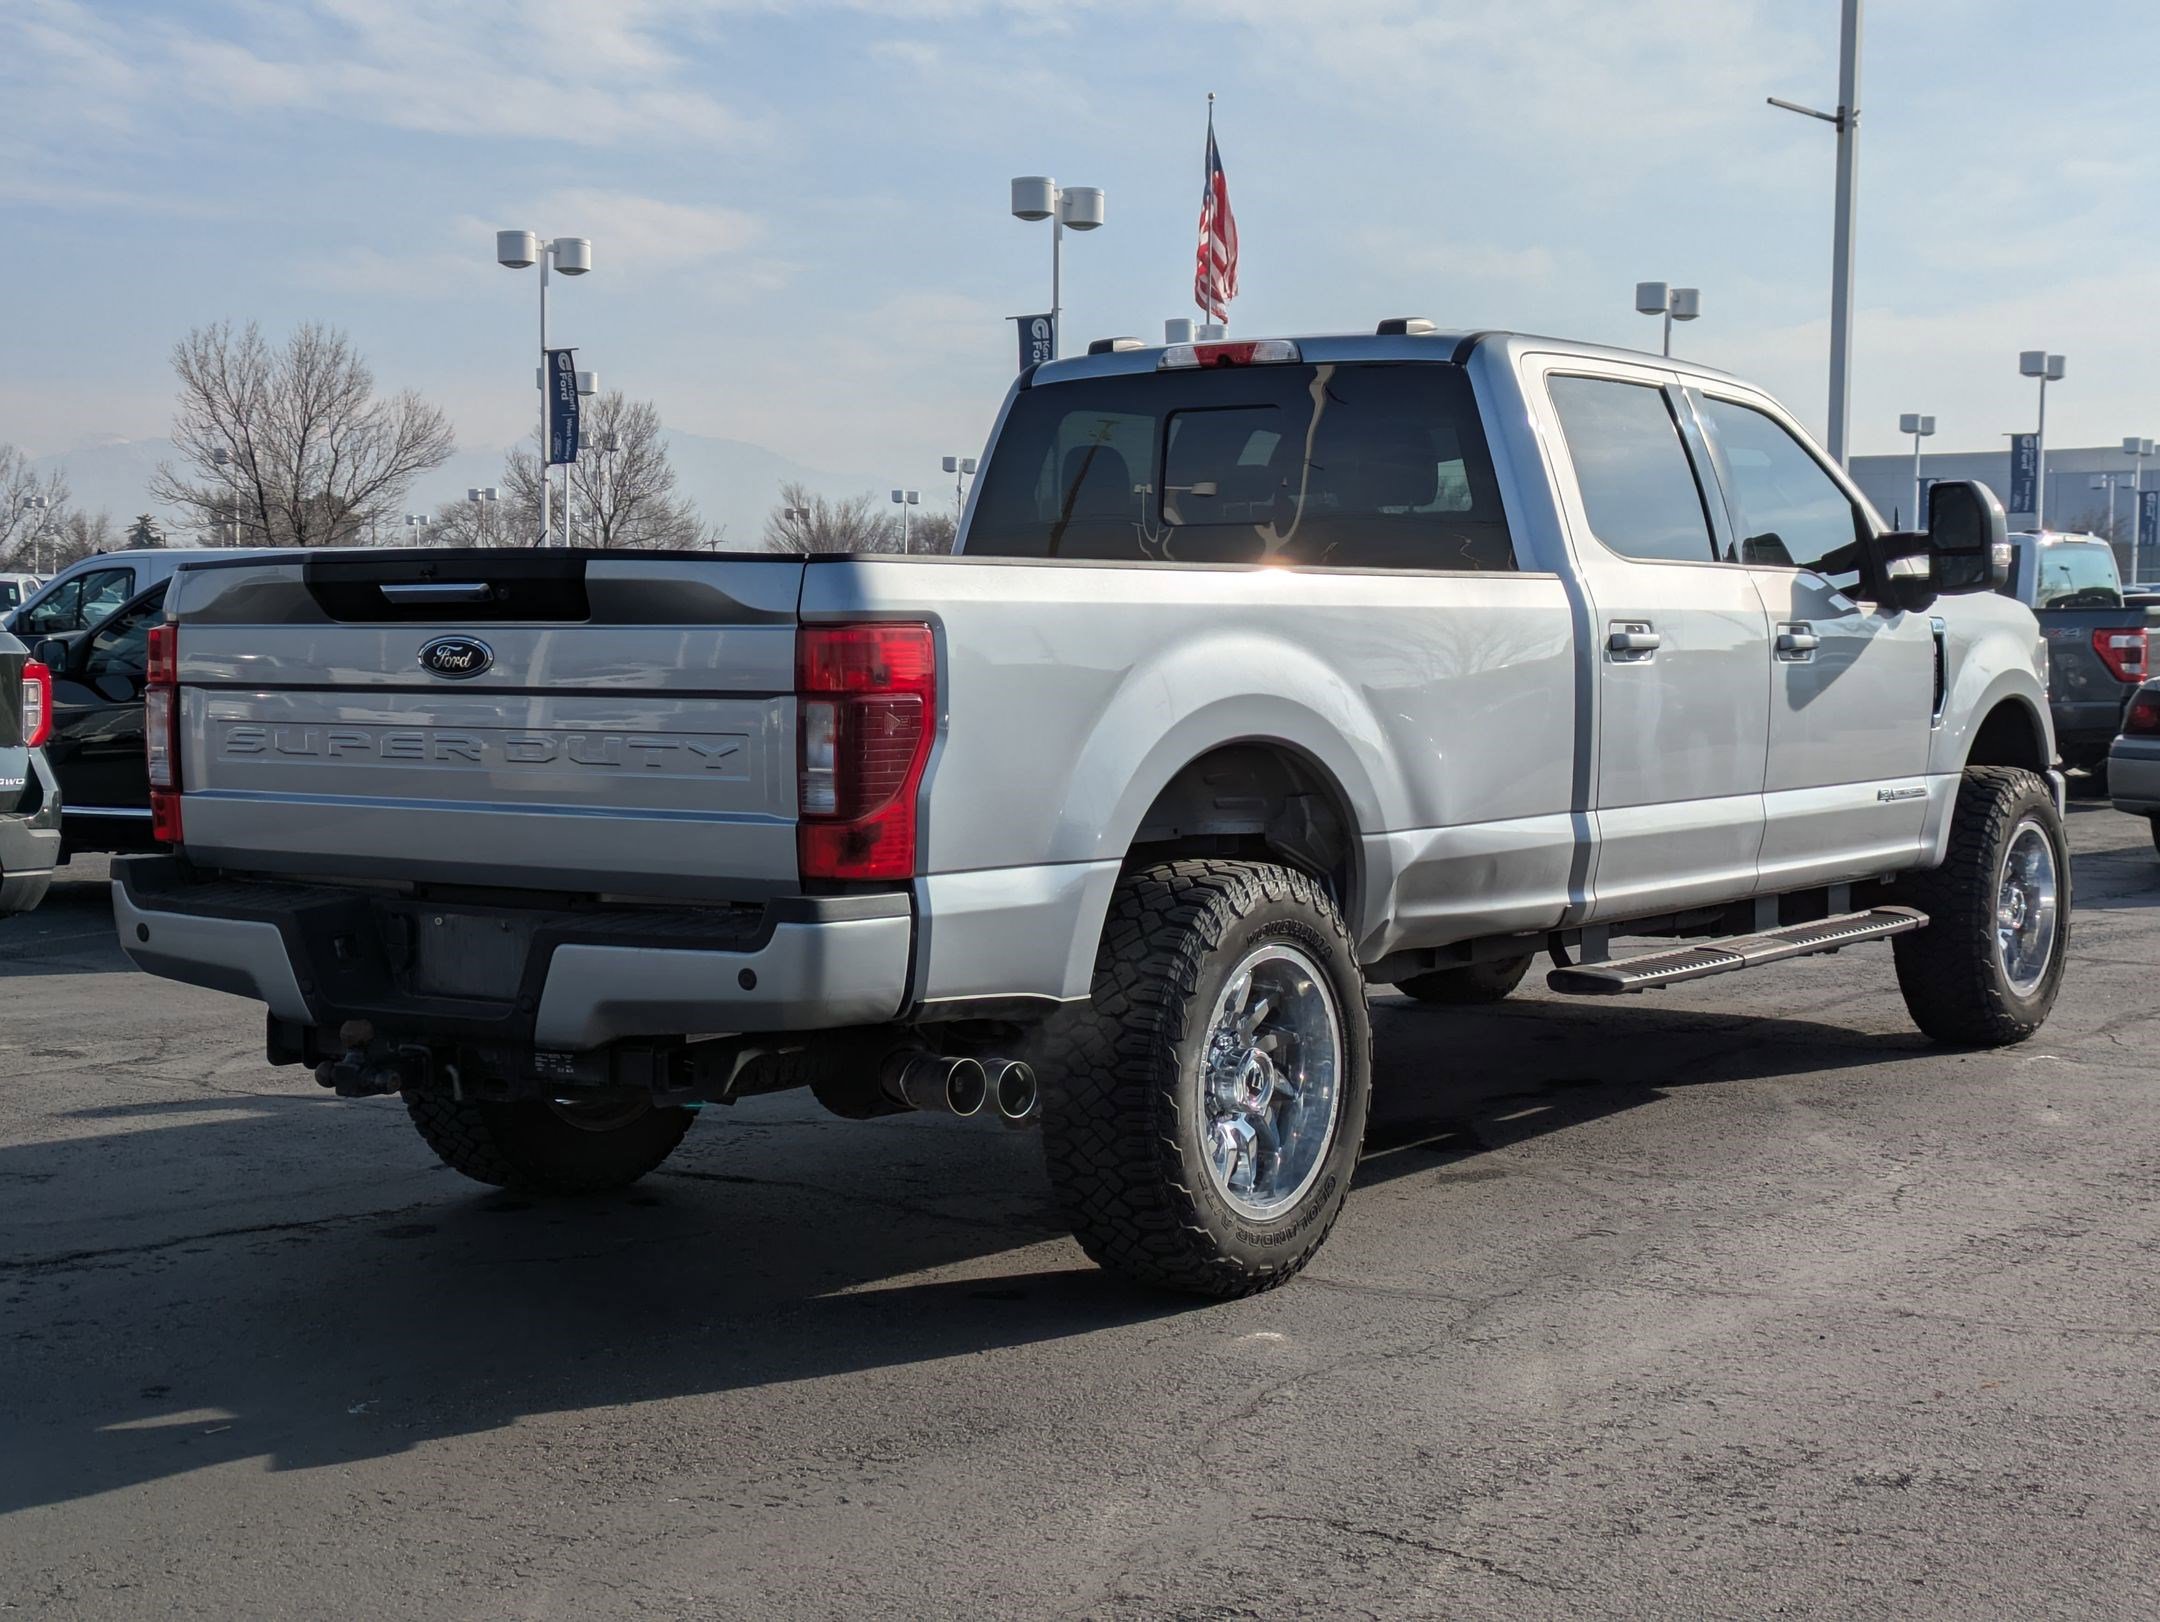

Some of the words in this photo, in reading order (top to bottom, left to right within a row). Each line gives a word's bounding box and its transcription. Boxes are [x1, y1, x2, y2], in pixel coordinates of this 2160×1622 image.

[1033, 341, 1042, 363] For
[559, 372, 569, 401] Ford
[567, 372, 575, 389] Ken
[568, 390, 577, 411] Garff
[564, 438, 573, 460] Valley
[2021, 449, 2029, 470] Ford
[433, 645, 473, 668] Ford
[226, 726, 483, 761] SUPER
[505, 736, 740, 769] DUTY
[1247, 919, 1335, 961] YOKOHAMA
[1235, 1174, 1336, 1248] GEOLANDAR
